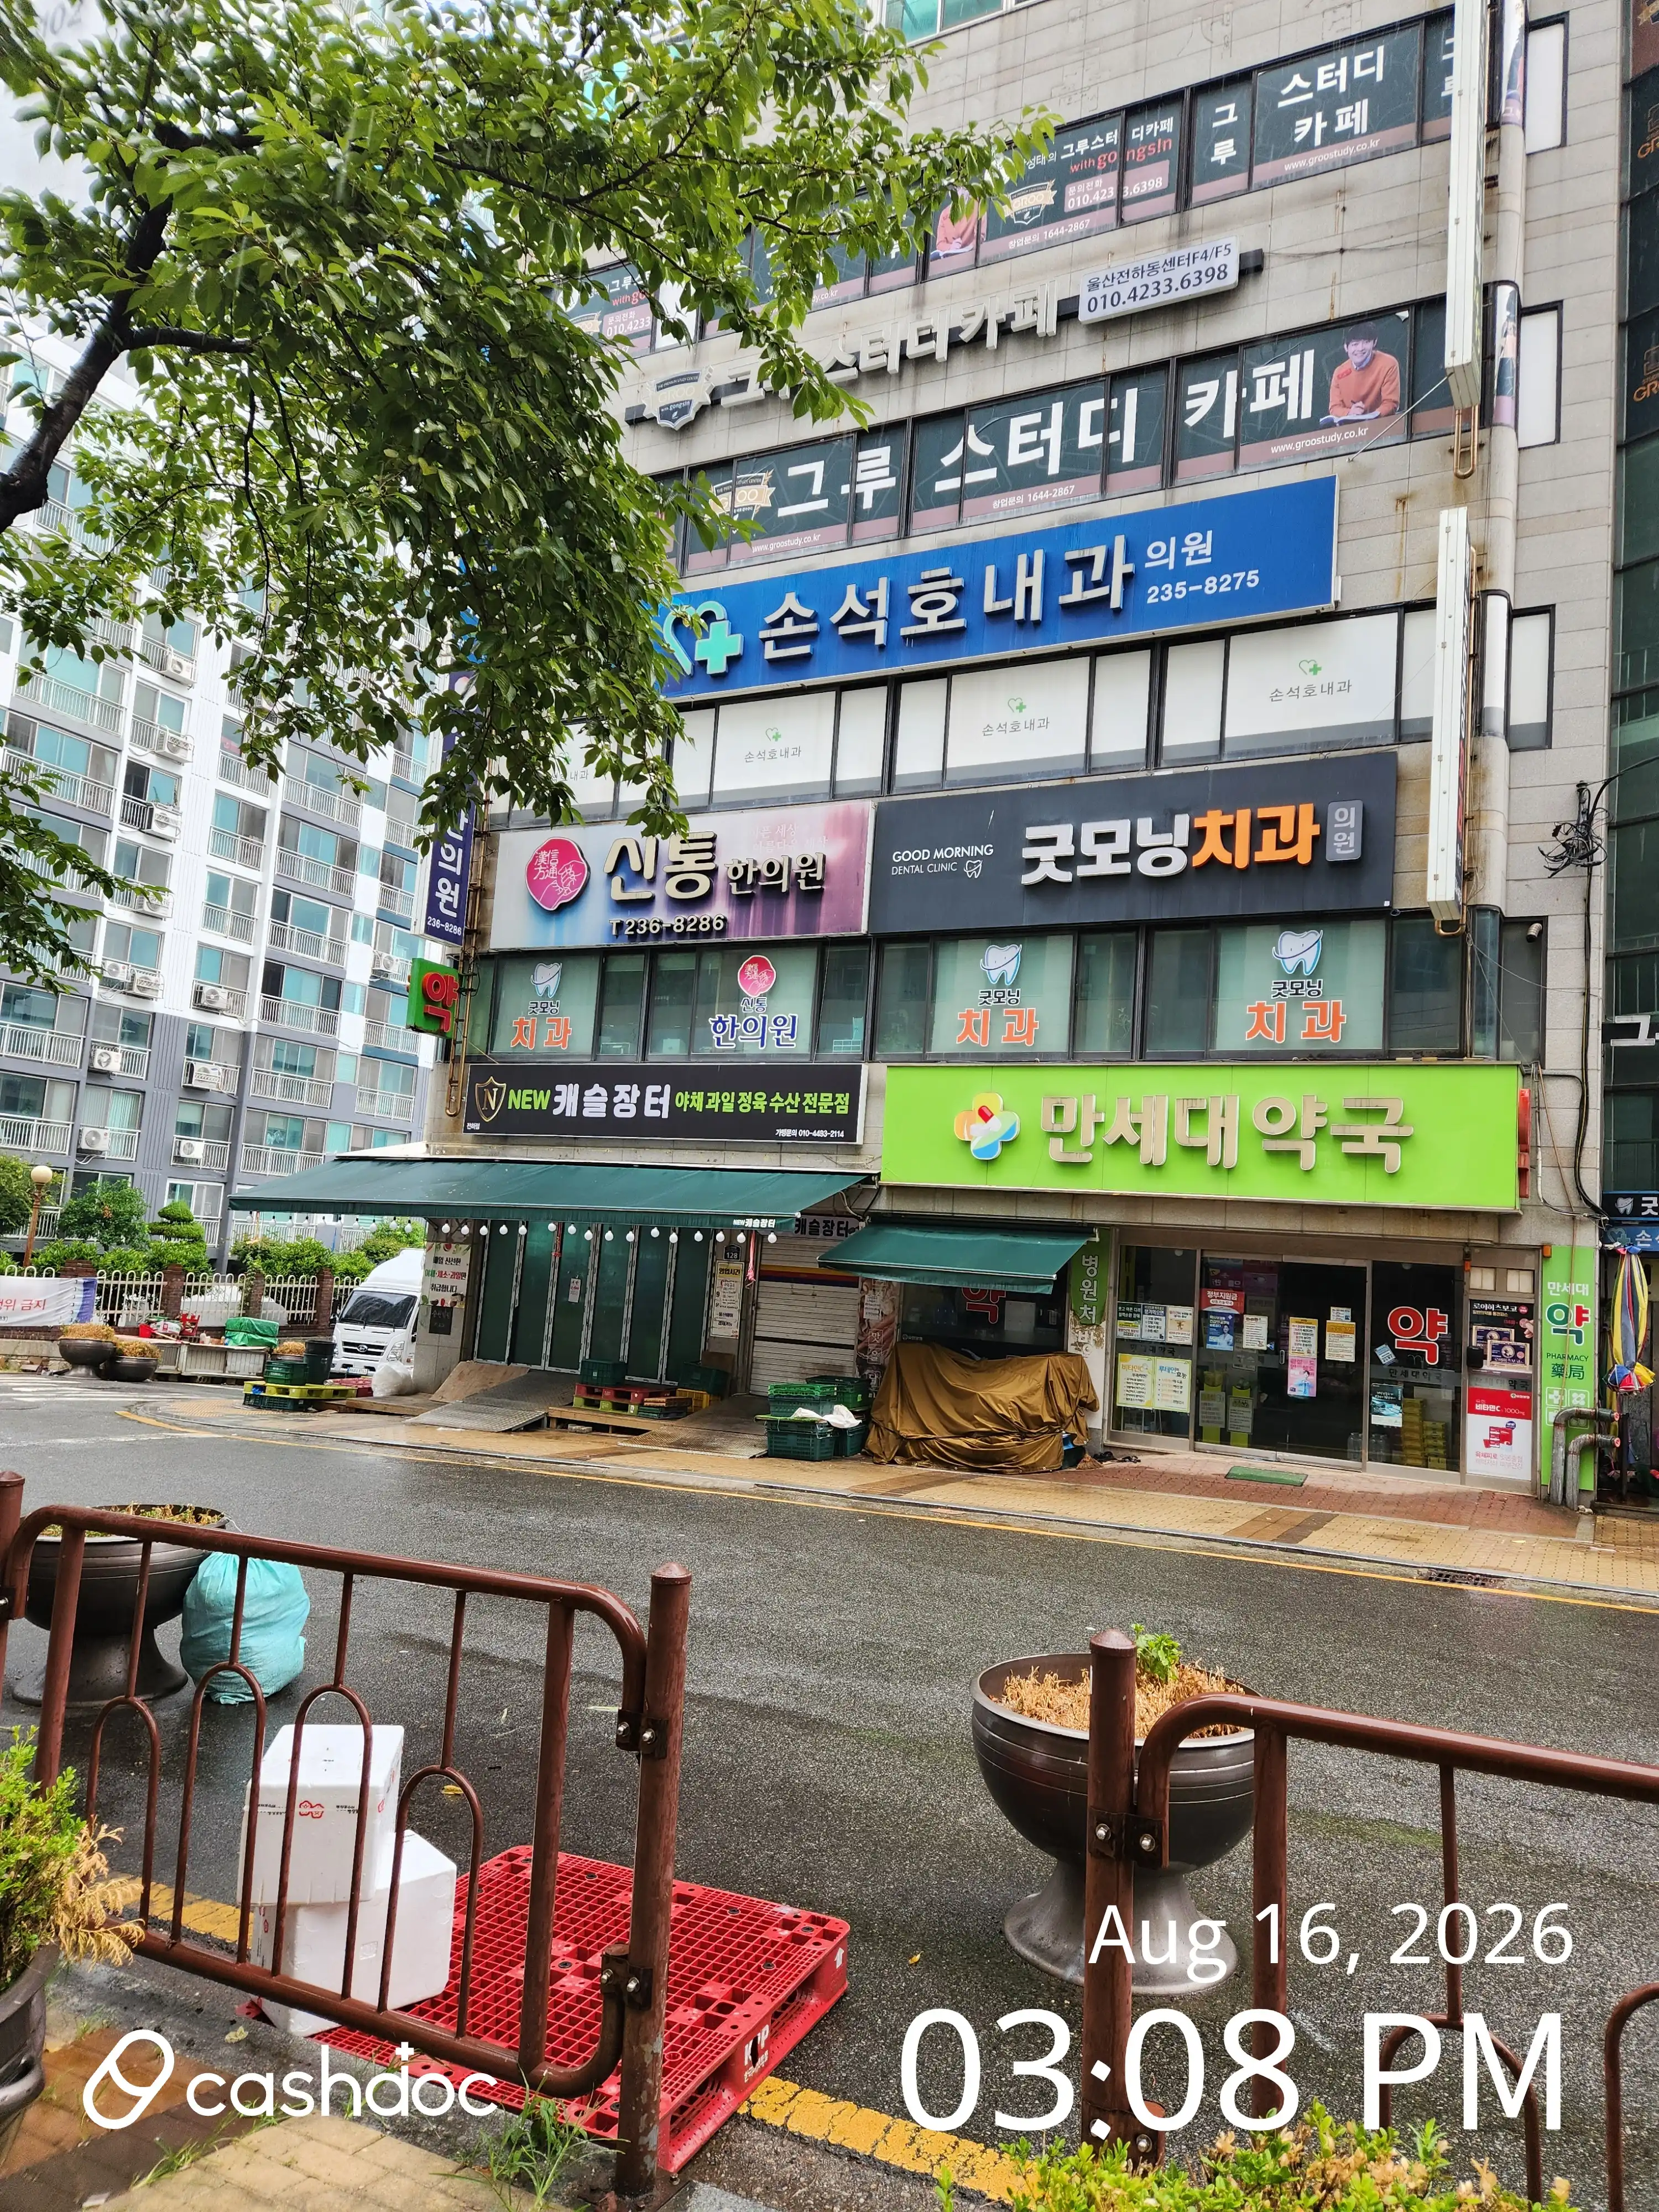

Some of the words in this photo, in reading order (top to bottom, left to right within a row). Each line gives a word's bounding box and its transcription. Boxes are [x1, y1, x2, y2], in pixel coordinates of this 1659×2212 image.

[1278, 45, 1384, 108] 스터디
[1295, 98, 1369, 147] 카페
[1022, 151, 1057, 170] 성태의
[1070, 159, 1095, 173] with
[1284, 138, 1380, 172] www.groostudy.co.kr
[1068, 178, 1103, 195] 문의전화
[1008, 232, 1040, 249] 창업문의
[1043, 218, 1091, 239] 1644-2867
[1087, 243, 1232, 293] 울산전하동센터F4/F5
[1087, 263, 1229, 313] 010.4233.6398
[612, 294, 631, 306] with
[608, 310, 636, 325] 문의전화
[658, 385, 696, 404] GROO
[778, 445, 897, 518] 그루
[934, 387, 1138, 493] 스터디
[1184, 348, 1315, 438] 카페
[1270, 427, 1369, 455] www.groostudy.co.kr
[992, 493, 1024, 510] 창업문의
[1027, 484, 1076, 504] 1644-2867
[752, 532, 821, 554] www.groostudy.co.kr
[758, 533, 1135, 662] 손석호내과
[1144, 529, 1214, 571] 의원
[1146, 568, 1261, 605] 235-8275
[1269, 679, 1353, 703] 손석호내과
[982, 715, 1050, 738] 손석호내과
[743, 744, 802, 764] 손석호내과
[1334, 807, 1355, 854] 의원
[892, 849, 931, 863] GOOD
[933, 844, 994, 859] MORNING
[603, 830, 719, 902] 신통
[724, 852, 827, 895] 한의원
[891, 864, 925, 875] DENTAL
[927, 862, 958, 873] CLINIC
[426, 915, 462, 936] 236-8286
[623, 914, 728, 936] 236-8286
[978, 988, 1022, 1005] 굿모닝
[1271, 979, 1323, 999] 굿모닝
[422, 971, 460, 1032] 약
[528, 999, 560, 1015] 굿모닝
[740, 997, 768, 1013] 신통
[708, 1014, 799, 1050] 한의원
[956, 1008, 1040, 1047] 치과
[1245, 999, 1347, 1044] 치과
[510, 1016, 573, 1051] 치과
[508, 1089, 551, 1110] NEW
[552, 1083, 671, 1119] 캐슬장터
[675, 1091, 704, 1112] 야채
[705, 1091, 735, 1113] 과일
[737, 1091, 768, 1113] 정육
[769, 1092, 801, 1113] 수산
[802, 1092, 850, 1114] 전문점
[467, 1122, 480, 1130] 전하점
[799, 1129, 844, 1138] 010-4493-2114
[794, 1218, 849, 1238] 캐슬장터
[1207, 1290, 1238, 1301] 정부지원금
[1547, 1281, 1589, 1297] 만세대
[20, 1298, 46, 1311] 금지
[1387, 1306, 1448, 1365] 약
[1545, 1302, 1591, 1347] 약
[1546, 1352, 1589, 1362] PHARMACY
